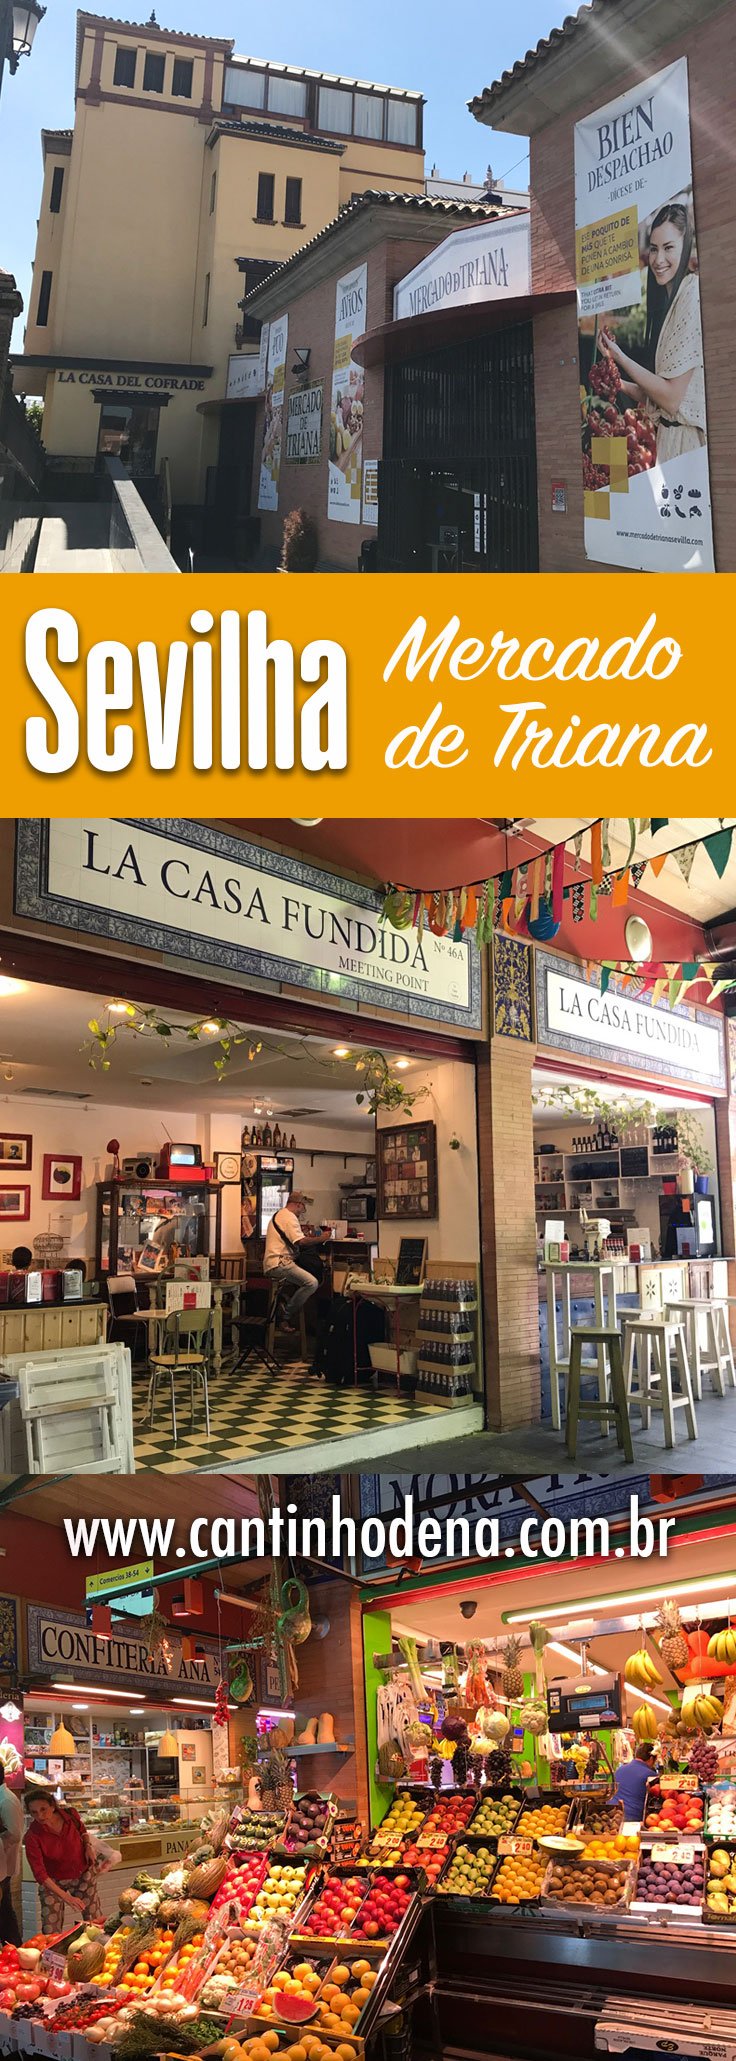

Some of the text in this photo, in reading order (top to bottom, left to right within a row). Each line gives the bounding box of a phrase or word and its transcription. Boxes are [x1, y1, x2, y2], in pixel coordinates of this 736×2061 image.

[597, 96, 654, 161] BIEN
[588, 131, 673, 192] DESPACHAO
[591, 220, 619, 238] POQUITO
[620, 216, 630, 227] DE
[581, 250, 602, 265] PONEN
[608, 238, 634, 253] CAMBIO
[594, 235, 607, 249] QUE
[608, 233, 616, 243] TE
[409, 272, 452, 316] MERCADO
[460, 246, 509, 288] TRIANA
[581, 266, 590, 276] DE
[591, 261, 604, 273] UNA
[58, 371, 205, 391] LA CASA DEL COFRADE
[288, 389, 321, 417] MERCADO
[300, 416, 308, 430] DE
[288, 430, 319, 456] TRIANA
[616, 530, 704, 546] www.mercadodetrianasevilla.com
[82, 829, 430, 973] LA CASA FUNDIDA
[447, 946, 464, 961] 46A
[338, 955, 393, 982] MEETING
[395, 972, 430, 992] POINT
[559, 987, 700, 1052] LA CASA FUNDIDA
[99, 1569, 139, 1585] Comercios 38-54
[178, 1656, 211, 1682] ANA
[703, 2045, 727, 2053] NORTE
